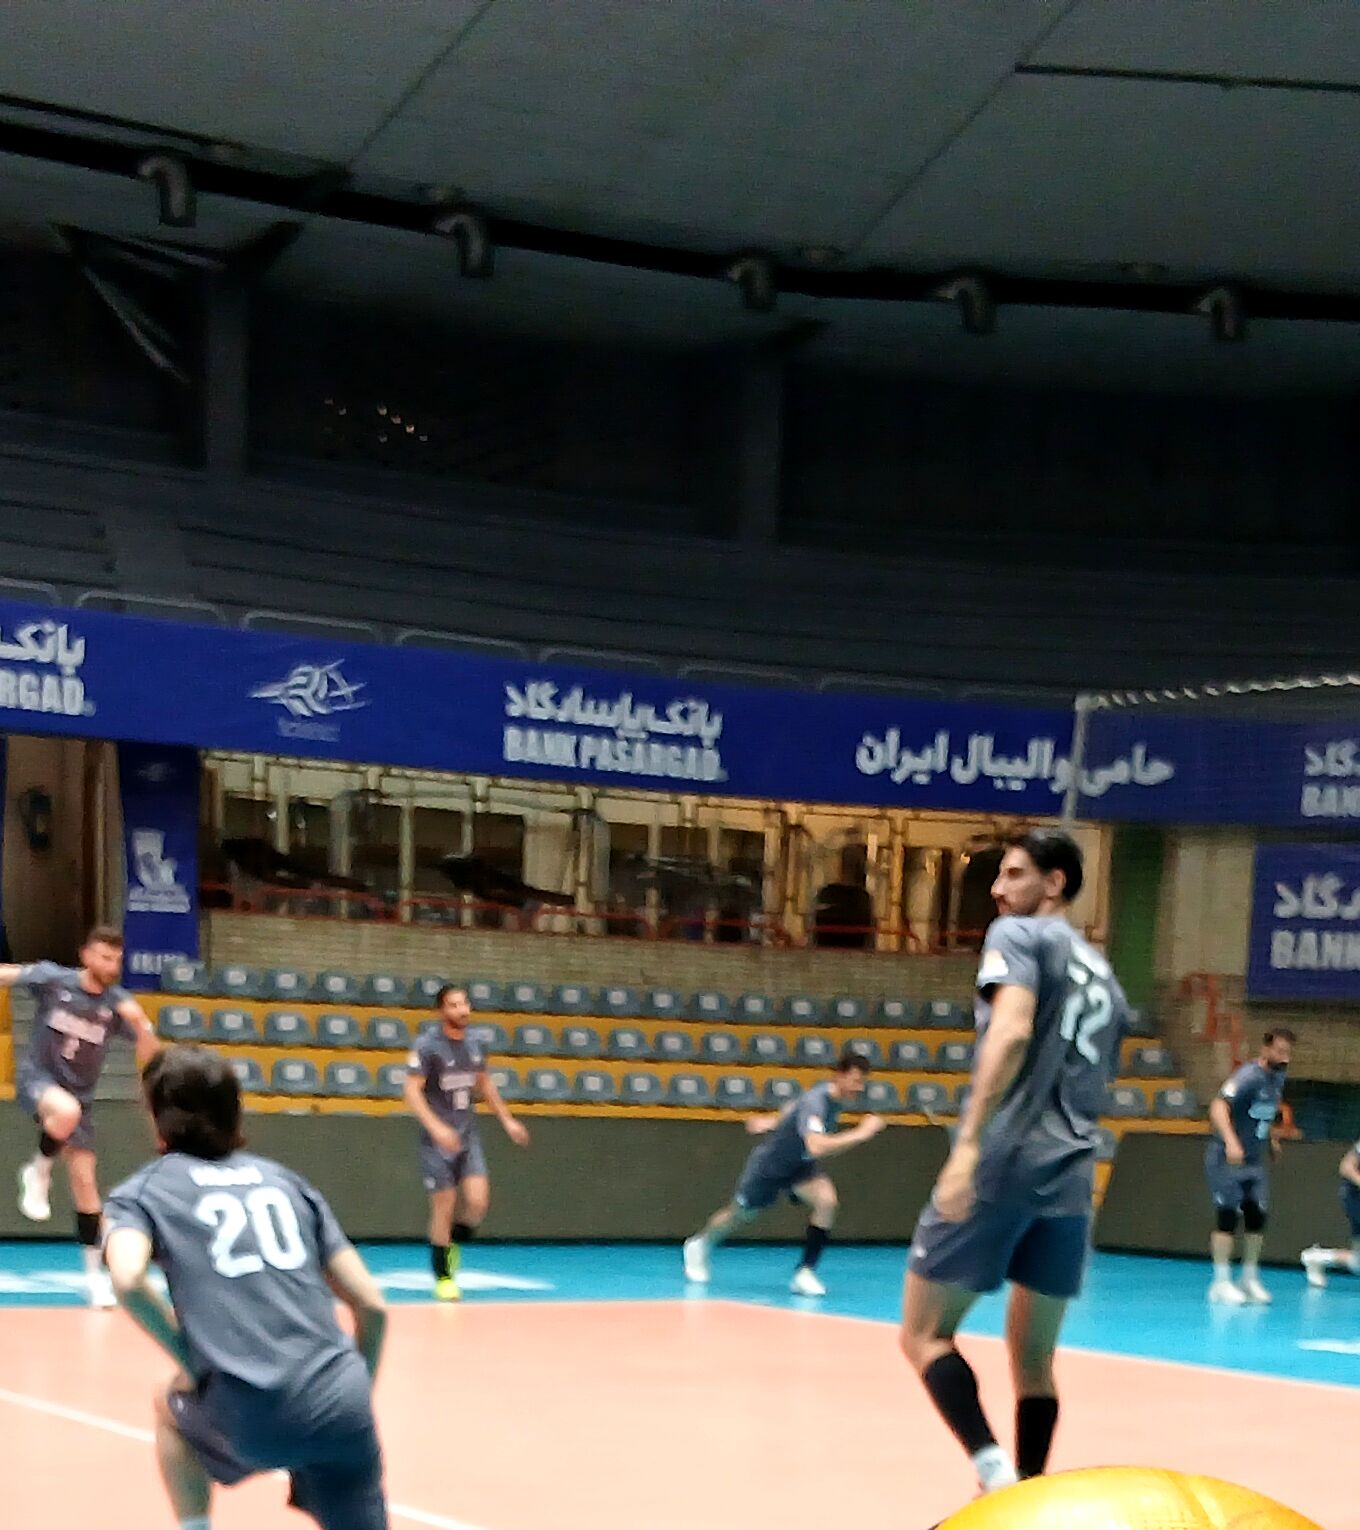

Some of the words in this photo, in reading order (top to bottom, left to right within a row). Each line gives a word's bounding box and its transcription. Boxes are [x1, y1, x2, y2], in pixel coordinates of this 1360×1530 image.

[856, 727, 950, 785] ایران
[1059, 984, 1113, 1065] 12
[195, 1187, 307, 1278] 20
